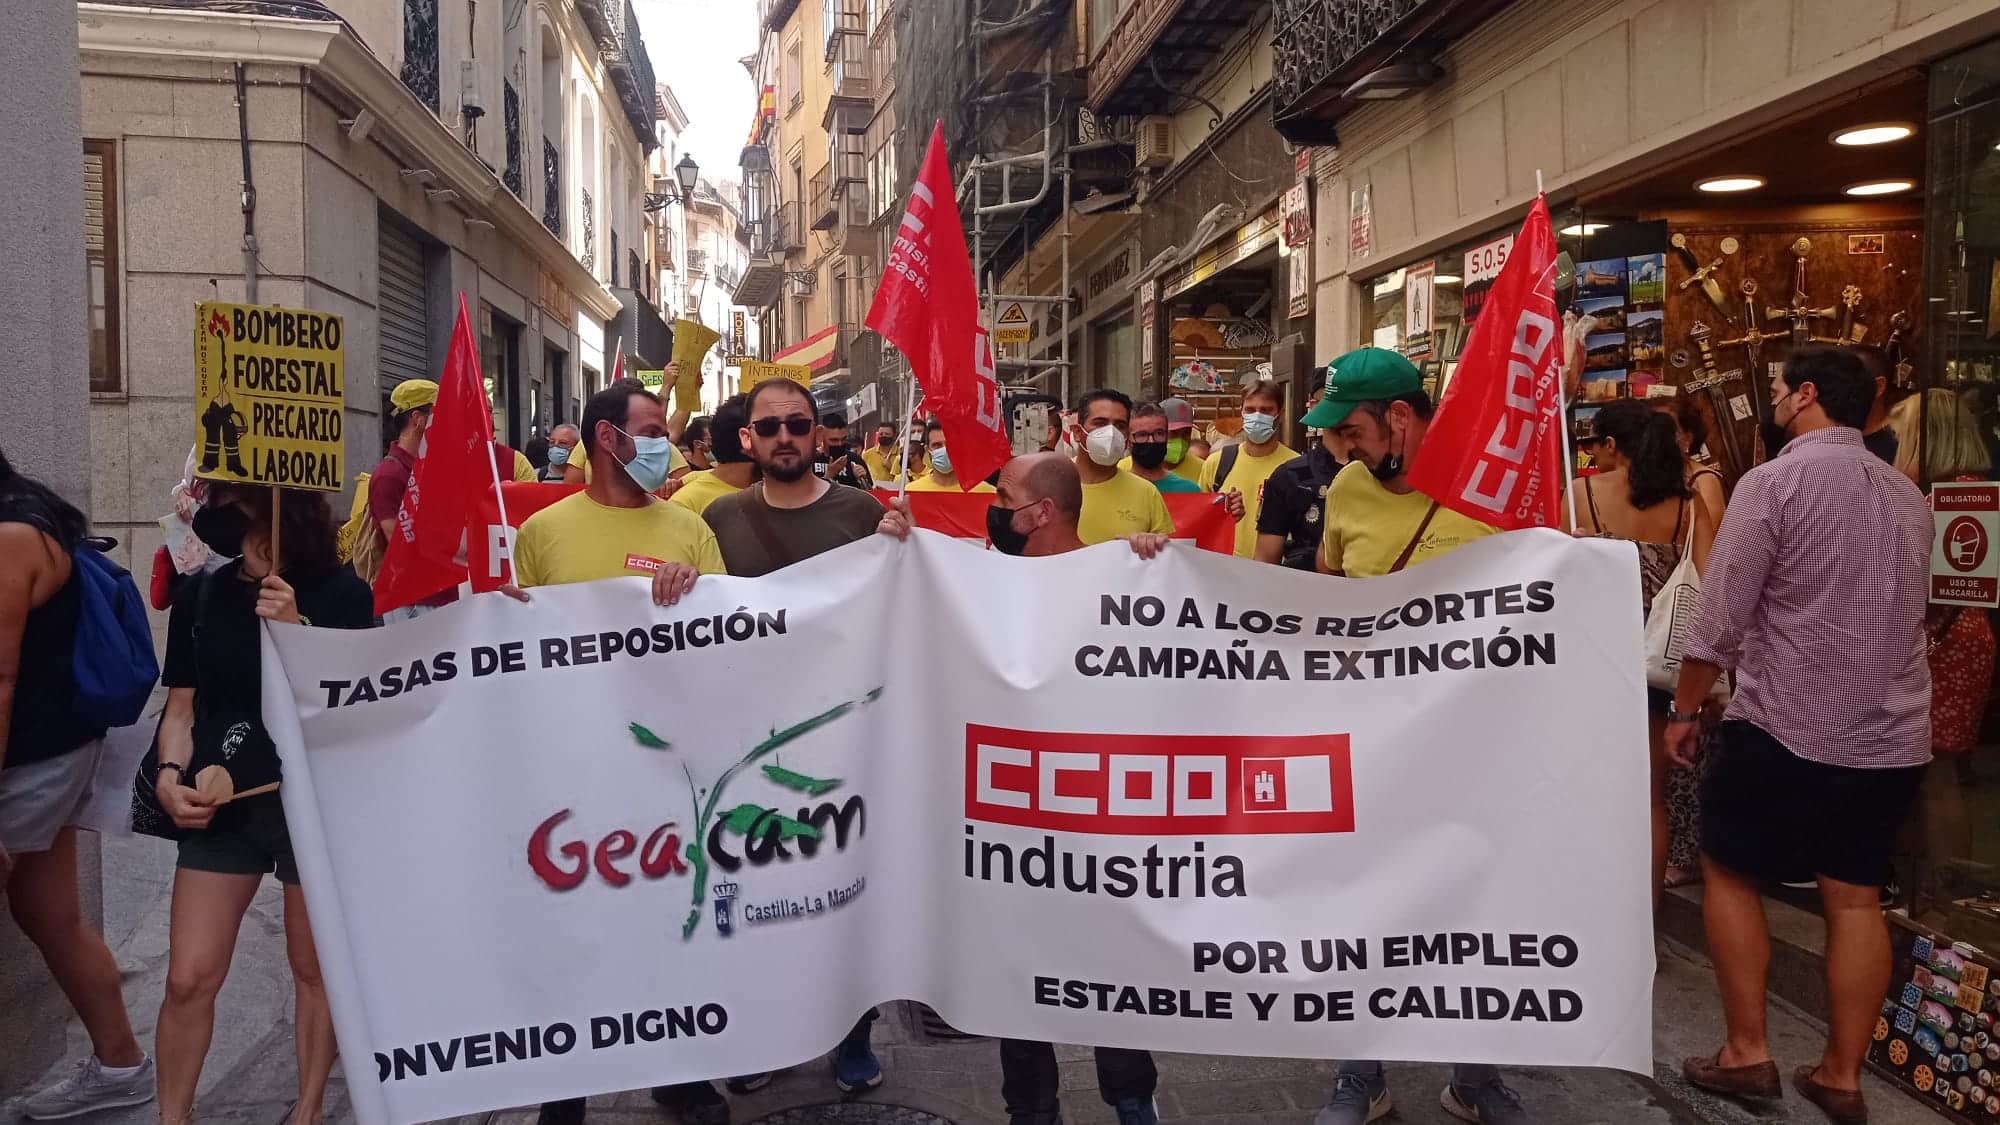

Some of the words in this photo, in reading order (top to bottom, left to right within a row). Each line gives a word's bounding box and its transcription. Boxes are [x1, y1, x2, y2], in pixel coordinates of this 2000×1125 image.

[233, 308, 341, 351] BOMBERO
[735, 312, 744, 356] HOSTAL
[233, 353, 342, 397] FORESTAL
[748, 365, 803, 380] INTERINOS
[253, 402, 342, 442] PRECARIO
[253, 447, 341, 488] LABORAL
[1940, 495, 1991, 503] OBLIGATORIO
[1939, 588, 1989, 599] MASCARILLA
[1949, 579, 1966, 587] USO
[1967, 579, 1979, 587] DE
[1100, 594, 1165, 628] NO
[1176, 597, 1204, 629] A
[1214, 602, 1302, 636] LOS
[1314, 580, 1555, 638] RECORTES
[320, 651, 456, 709] TASAS
[471, 641, 527, 677] DE
[539, 605, 788, 668] REPOSICIÓN
[1074, 639, 1290, 681] CAMPAÑA
[1303, 627, 1557, 681] EXTINCIÓN
[976, 743, 1227, 817] CCOO
[964, 824, 1247, 899] industria
[744, 896, 823, 922] Castilla-La
[1192, 940, 1289, 974] POR
[1301, 937, 1368, 972] UN
[1382, 933, 1579, 969] EMPLEO
[1033, 975, 1233, 1020] ESTABLE
[1246, 992, 1280, 1021] Y
[1293, 990, 1356, 1022] DE
[1367, 985, 1584, 1023] CALIDAD
[374, 1022, 577, 1083] ONVENIO
[589, 1003, 728, 1049] DIGNO
